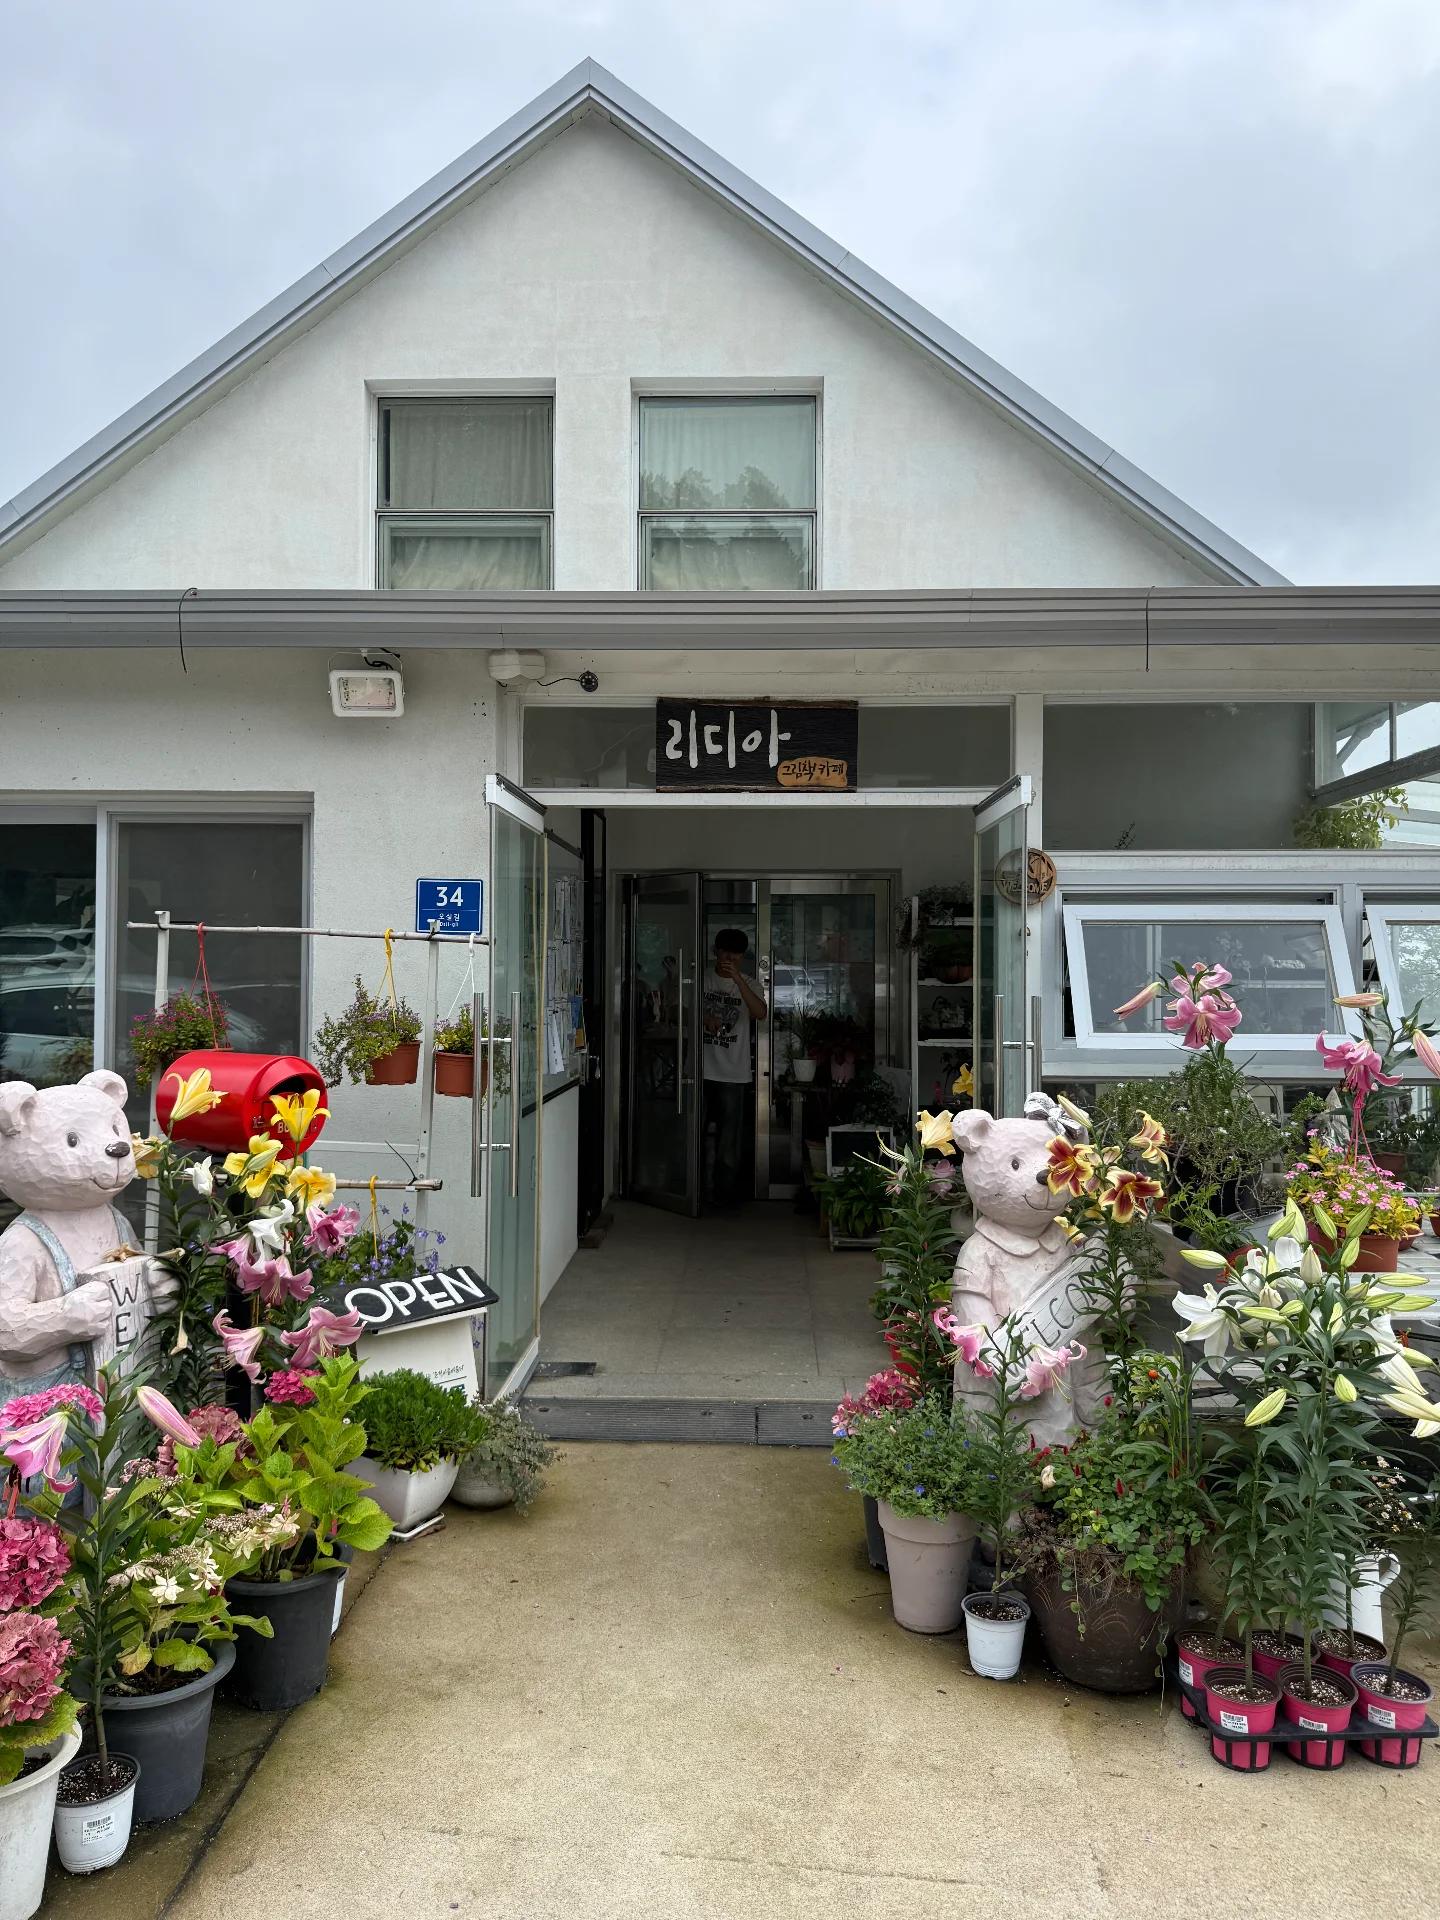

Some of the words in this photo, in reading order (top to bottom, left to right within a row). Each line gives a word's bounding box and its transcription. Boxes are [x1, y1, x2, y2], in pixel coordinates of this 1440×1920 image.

[666, 709, 791, 768] 리디아
[818, 761, 844, 777] 카페
[436, 886, 464, 907] 34
[344, 1267, 486, 1323] OPEN
